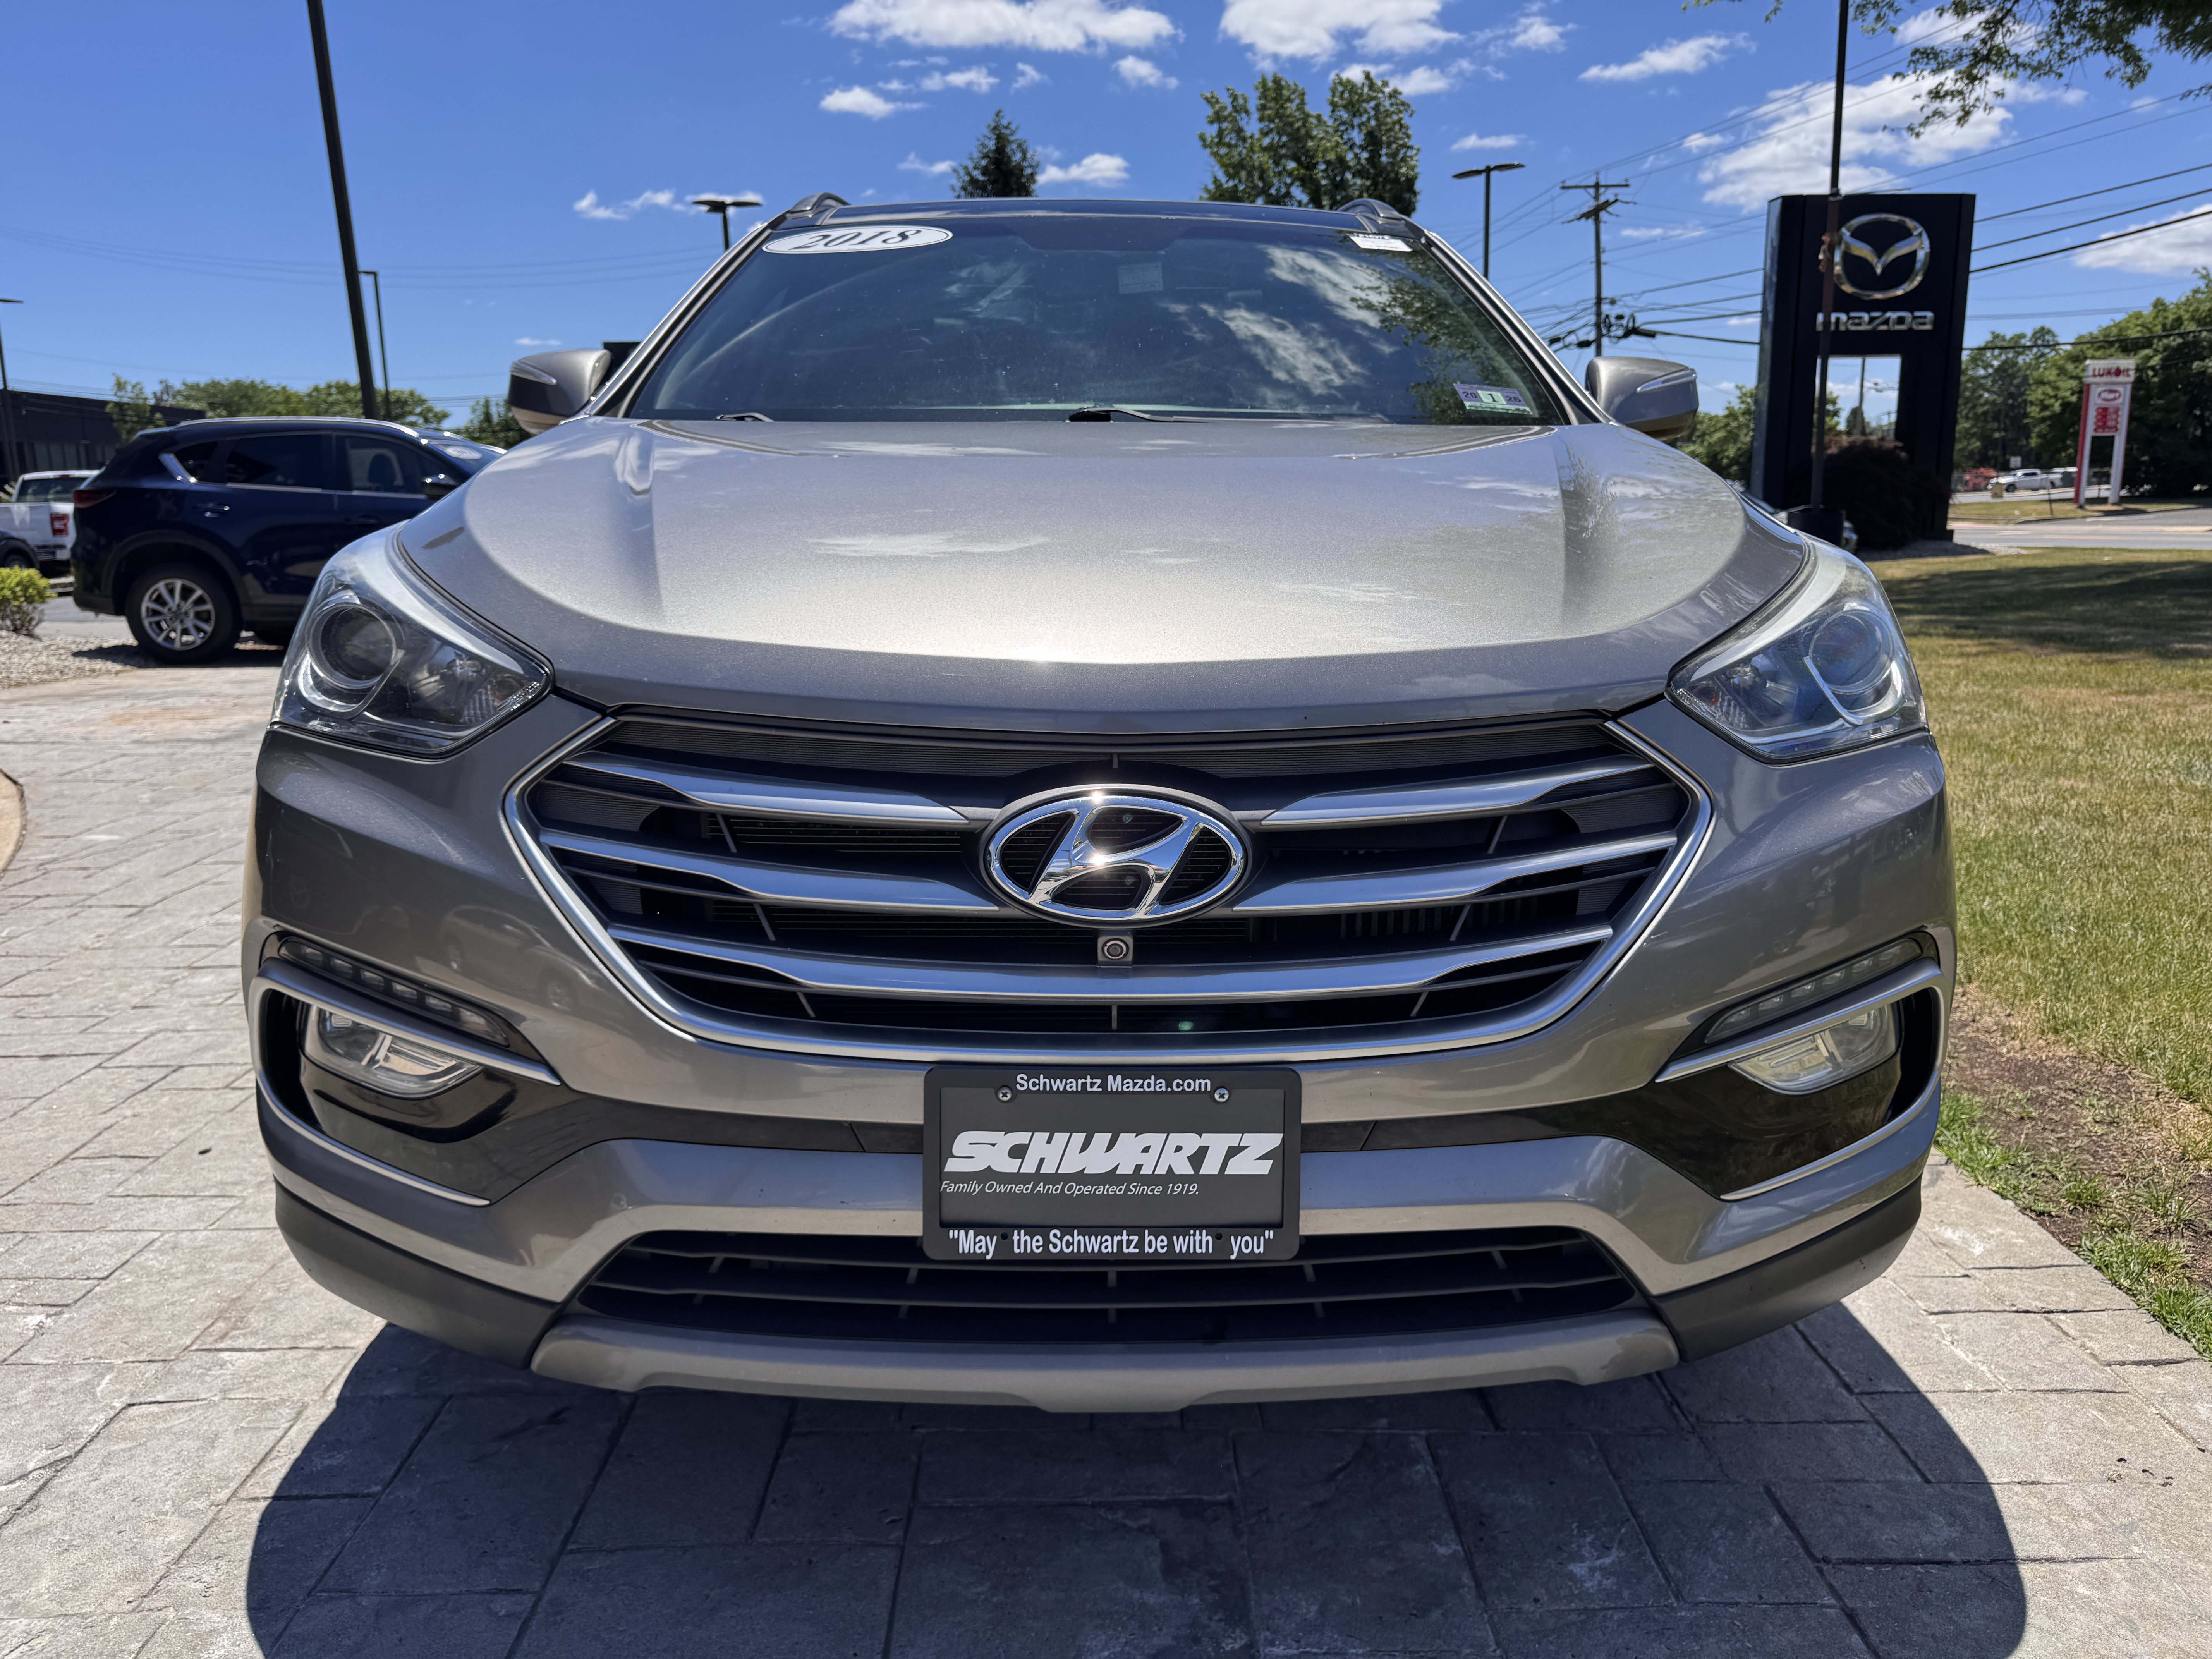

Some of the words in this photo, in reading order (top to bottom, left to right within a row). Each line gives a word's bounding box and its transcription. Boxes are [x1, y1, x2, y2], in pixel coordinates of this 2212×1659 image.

[788, 229, 922, 250] 2018
[1488, 393, 1499, 403] 1
[1016, 1073, 1102, 1092] Schwartz
[1107, 1075, 1211, 1092] Mazda.com
[943, 1131, 1283, 1175] SCHWARTZ
[940, 1180, 984, 1195] Family
[984, 1180, 1032, 1193] Owned
[1034, 1181, 1061, 1194] And
[1064, 1182, 1125, 1197] Operated
[1127, 1183, 1163, 1195] Since
[1166, 1183, 1199, 1195] 1919.
[949, 1229, 997, 1259] "May
[1012, 1229, 1043, 1254] the
[1048, 1228, 1139, 1254] Schwartz
[1144, 1229, 1168, 1254] be
[1173, 1229, 1212, 1254] with
[1230, 1230, 1274, 1259] you"
